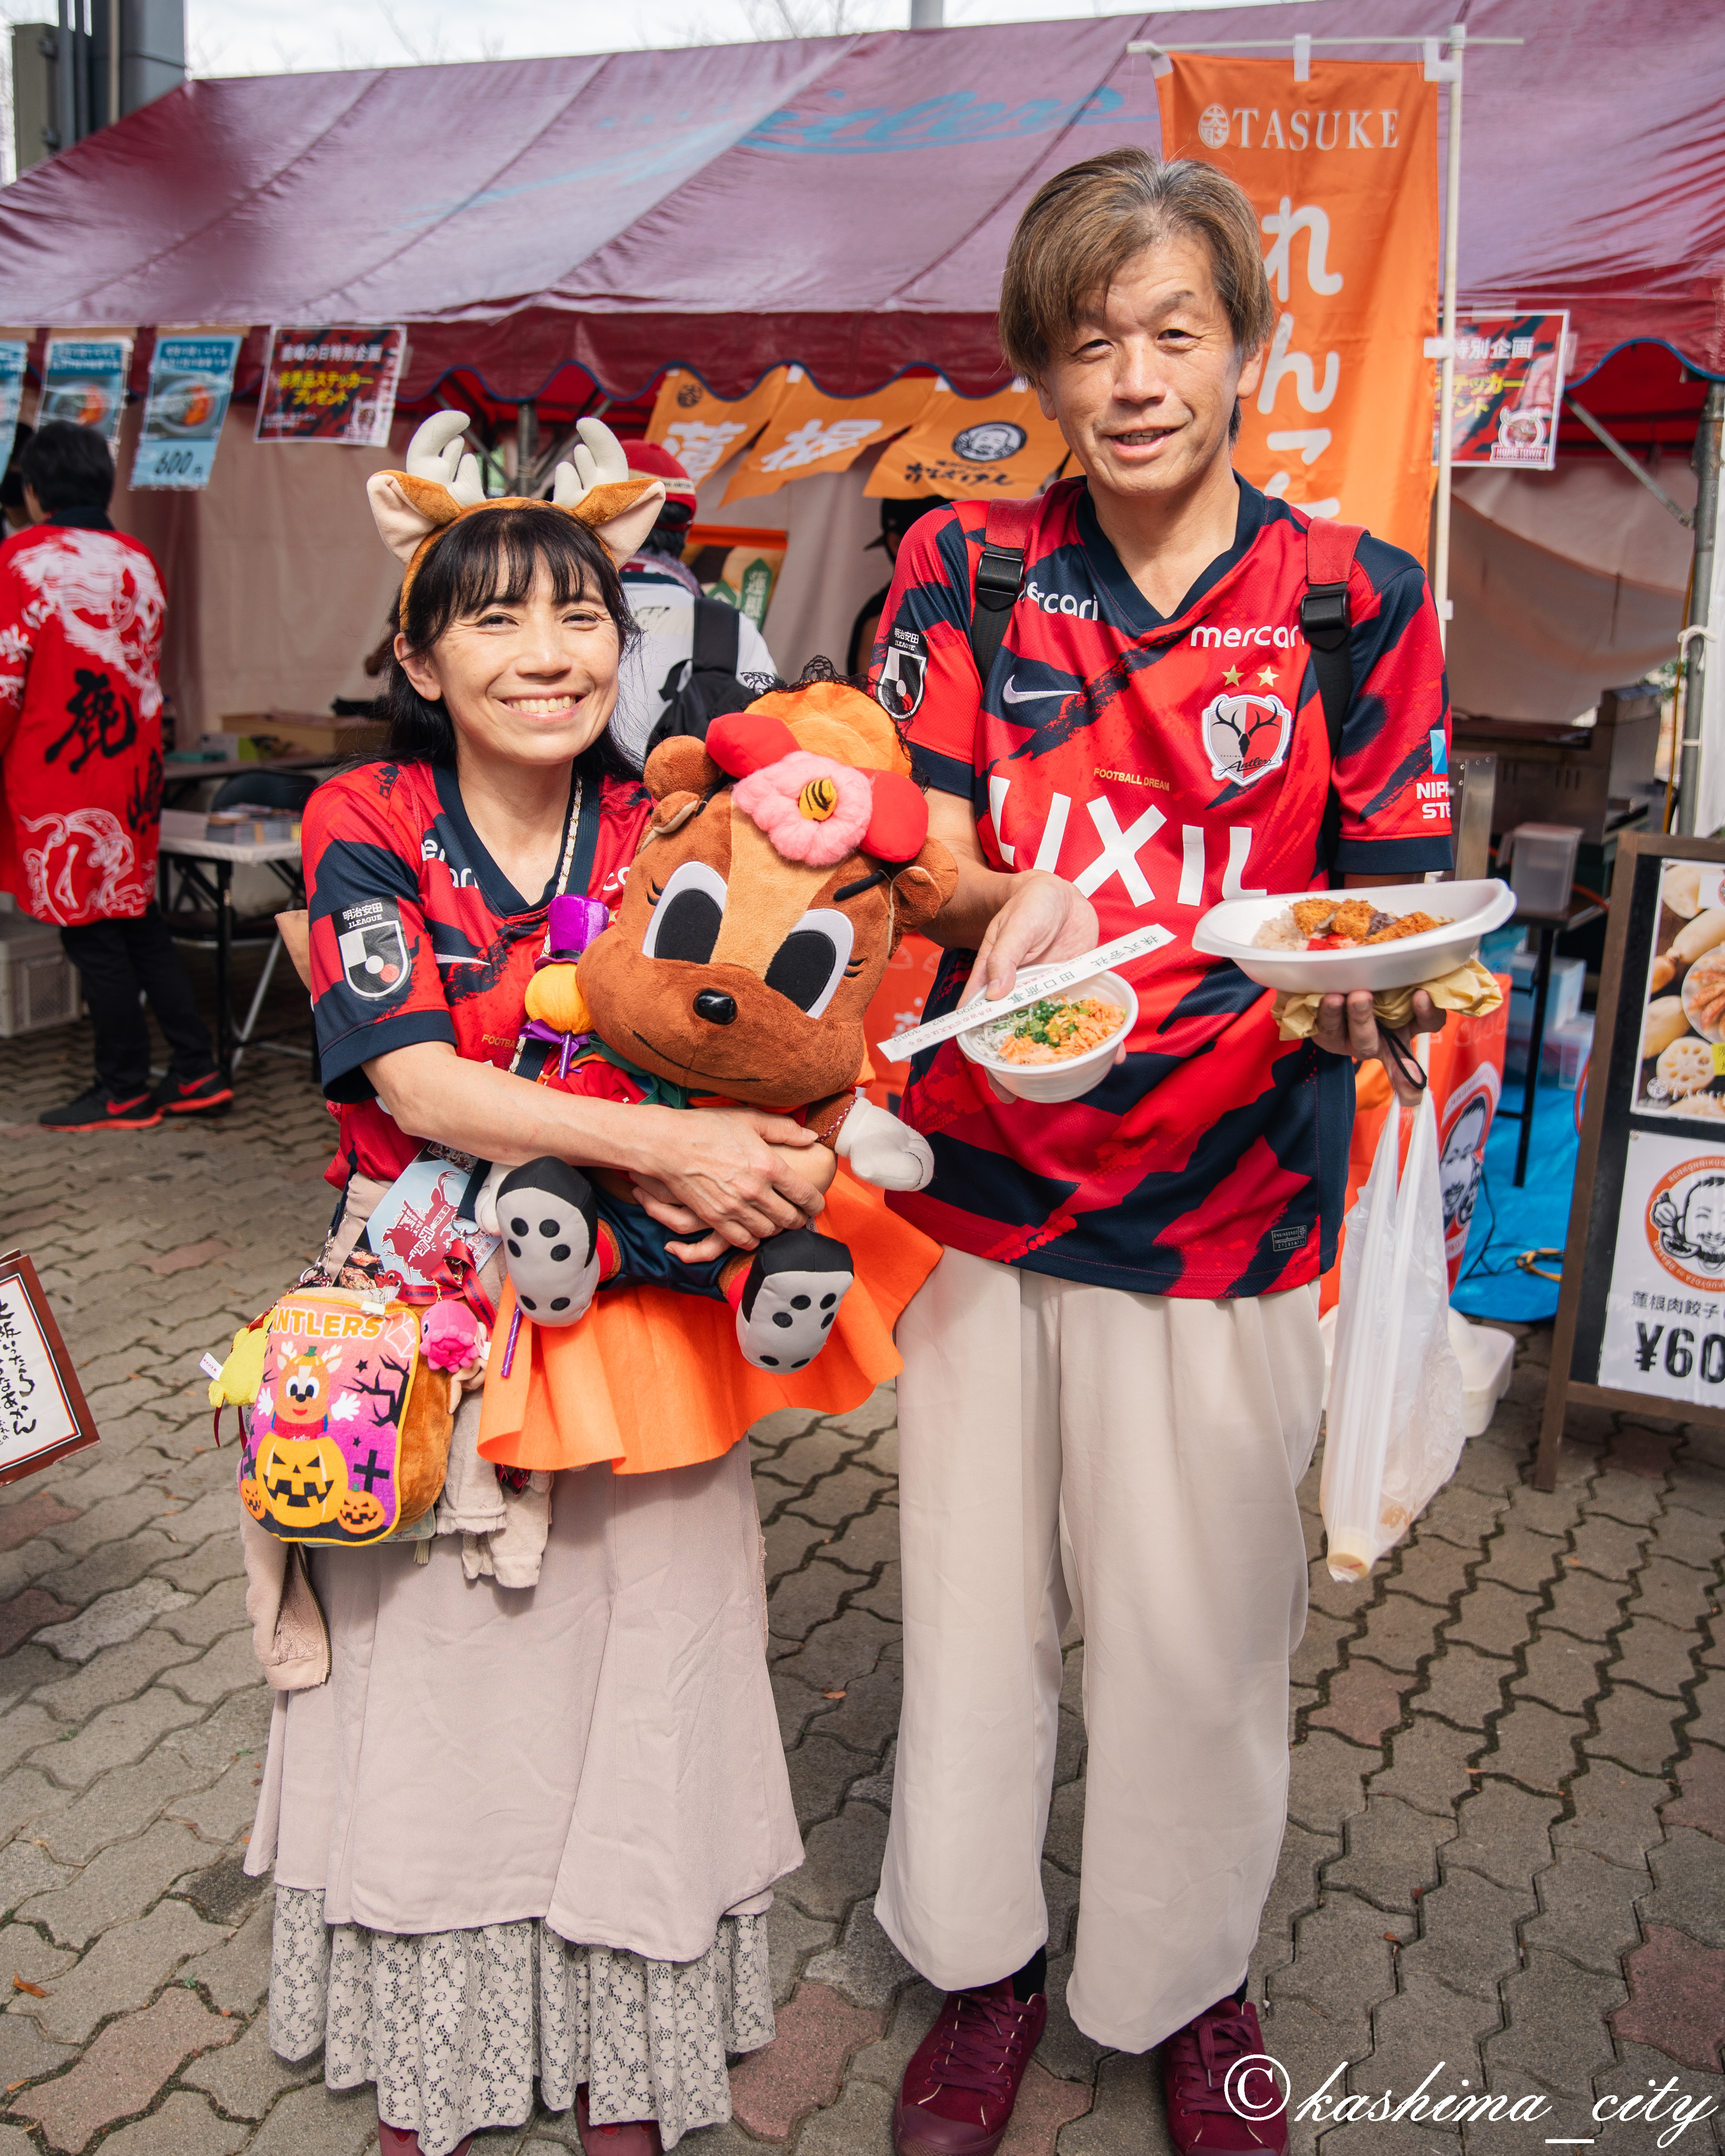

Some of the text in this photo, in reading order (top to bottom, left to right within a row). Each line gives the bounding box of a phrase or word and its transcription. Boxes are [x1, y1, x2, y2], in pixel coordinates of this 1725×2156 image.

[1232, 109, 1399, 150] TASUKE
[1017, 581, 1098, 621] ercari
[894, 627, 919, 644] 明治安田
[1191, 624, 1305, 648] mercar
[1217, 756, 1276, 776] Antlers
[1094, 767, 1170, 791] FOOTBALL DREAM
[989, 775, 1268, 908] LIXIL
[342, 902, 383, 921] 明治安田
[1008, 934, 1159, 1004] 株式会社 田口商事
[481, 1034, 515, 1048] FOOTBA
[272, 1307, 385, 1338] NTLERS
